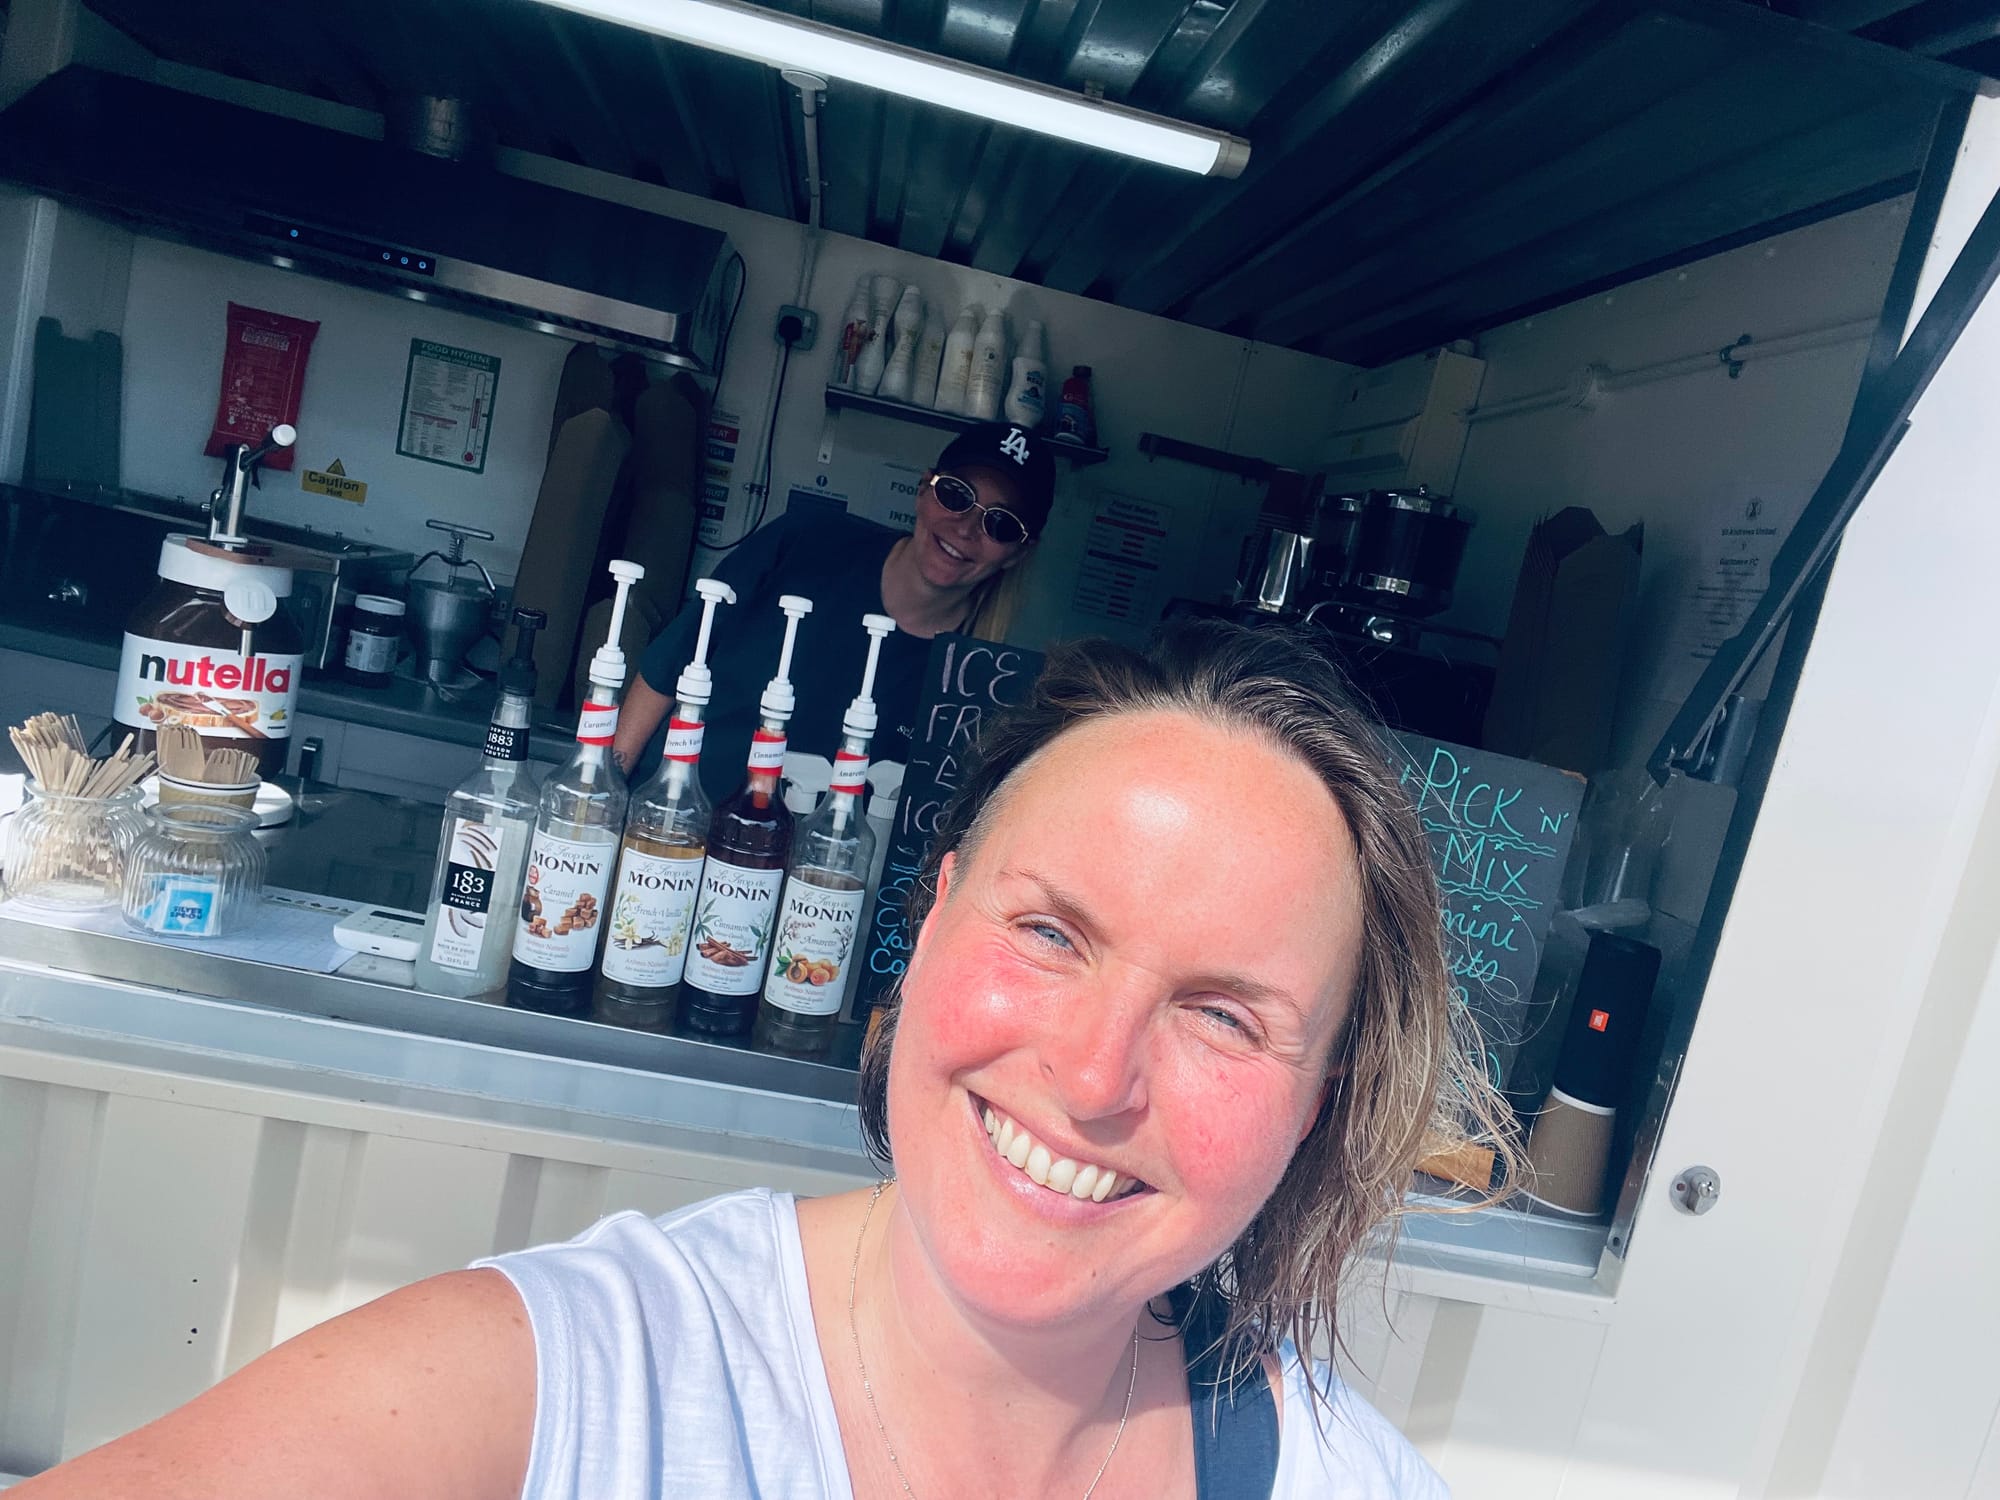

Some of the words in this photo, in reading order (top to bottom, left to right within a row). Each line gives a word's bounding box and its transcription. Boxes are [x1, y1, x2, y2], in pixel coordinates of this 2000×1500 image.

[999, 427, 1030, 466] LA
[308, 471, 360, 492] Caution
[139, 653, 291, 693] nutella
[942, 641, 1021, 708] ICE
[583, 720, 613, 730] Caramel
[488, 731, 514, 747] 1883
[533, 849, 600, 876] MONIN
[452, 870, 485, 894] 1883
[627, 870, 697, 892] MONIN
[705, 877, 772, 902] MONIN
[449, 896, 481, 908] FRANCE
[789, 898, 855, 922] MONIN
